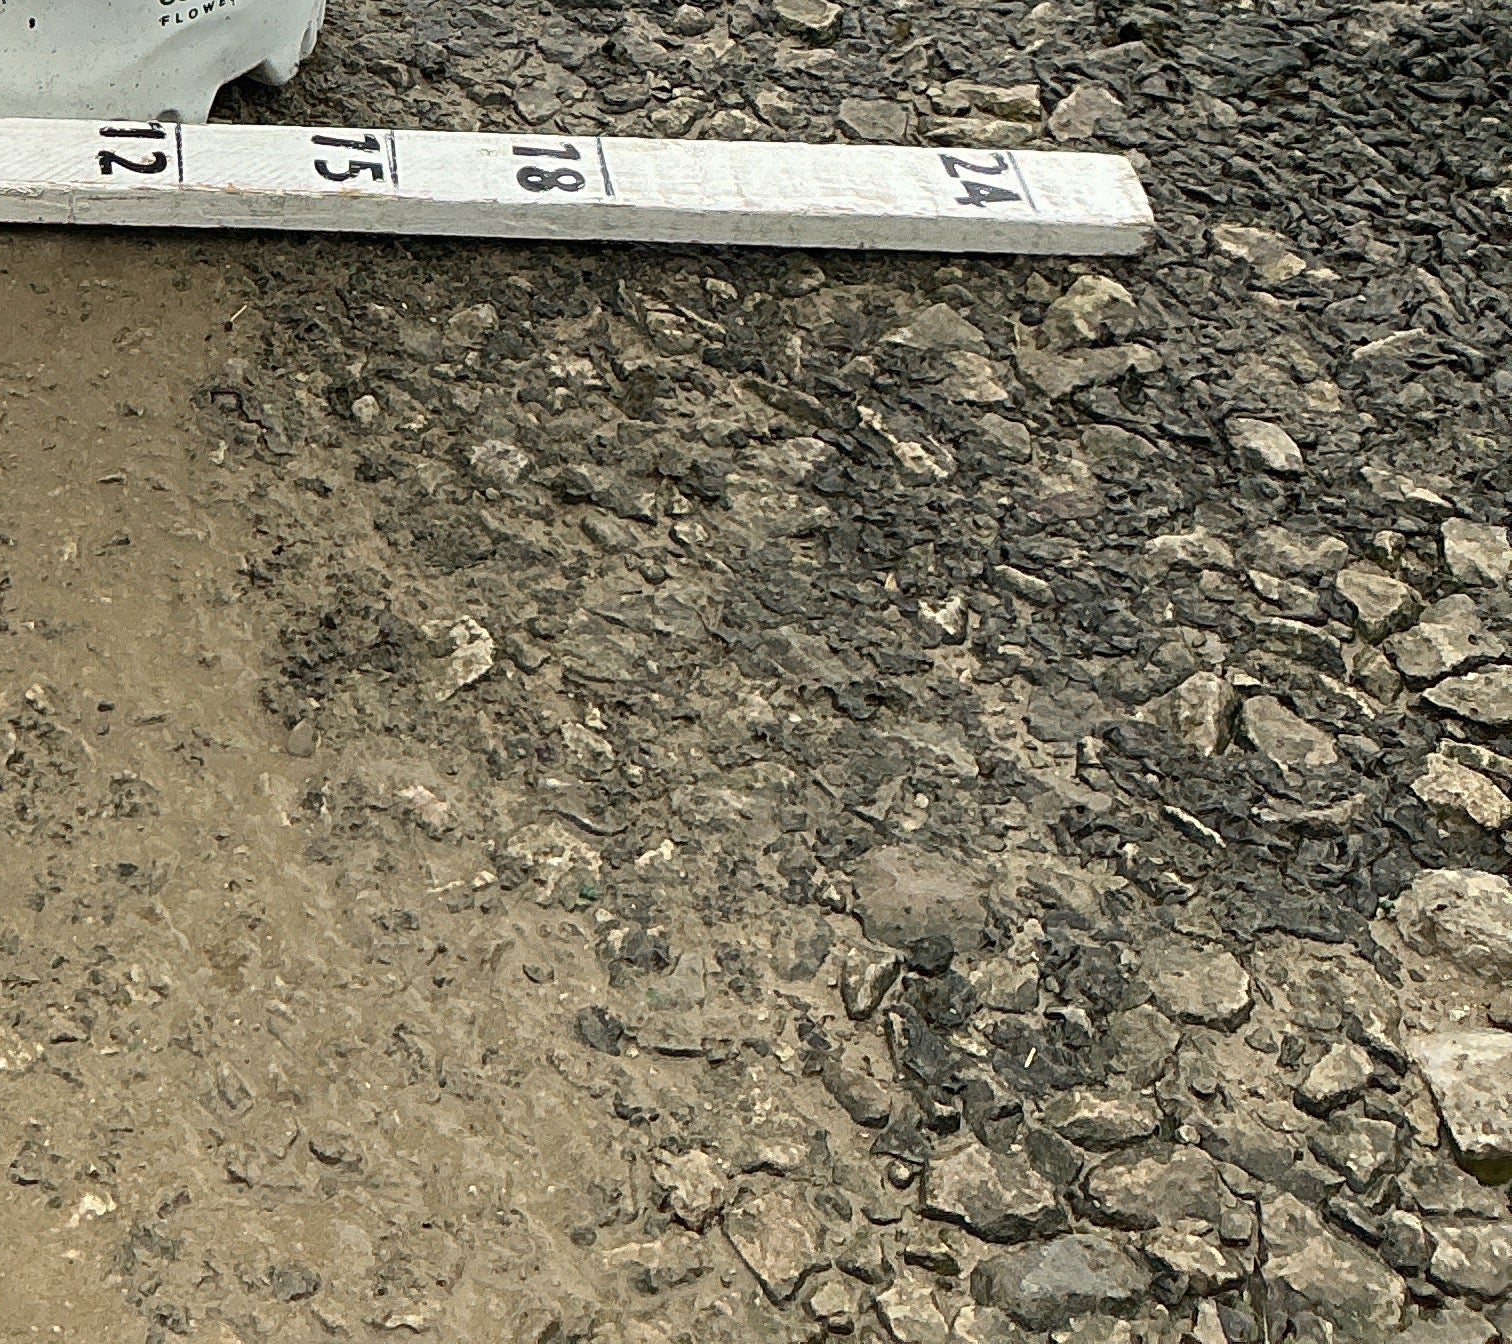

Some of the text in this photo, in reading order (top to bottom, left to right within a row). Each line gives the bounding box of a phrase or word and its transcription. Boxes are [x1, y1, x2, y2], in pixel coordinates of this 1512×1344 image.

[97, 119, 168, 175] 12
[310, 133, 385, 182] 15
[512, 141, 585, 192] 18
[937, 152, 1022, 208] 24
